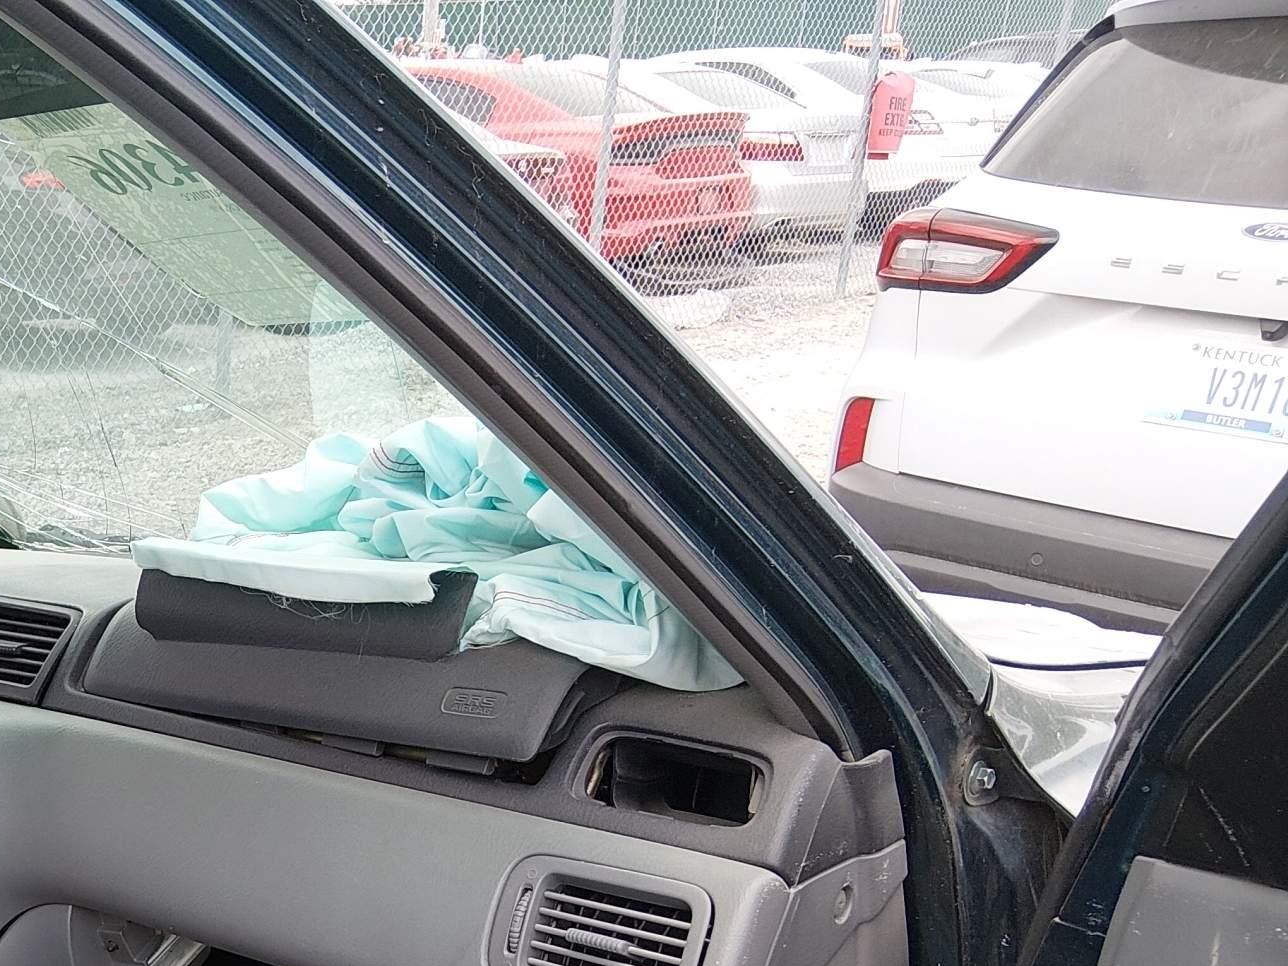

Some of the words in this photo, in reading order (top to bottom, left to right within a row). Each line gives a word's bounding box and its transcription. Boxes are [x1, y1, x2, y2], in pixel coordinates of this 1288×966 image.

[889, 96, 907, 112] FIRE
[1206, 367, 1288, 417] V3M1
[1206, 414, 1247, 429] BUTLER
[454, 694, 497, 708] SRS
[451, 704, 493, 715] AIRBAG
